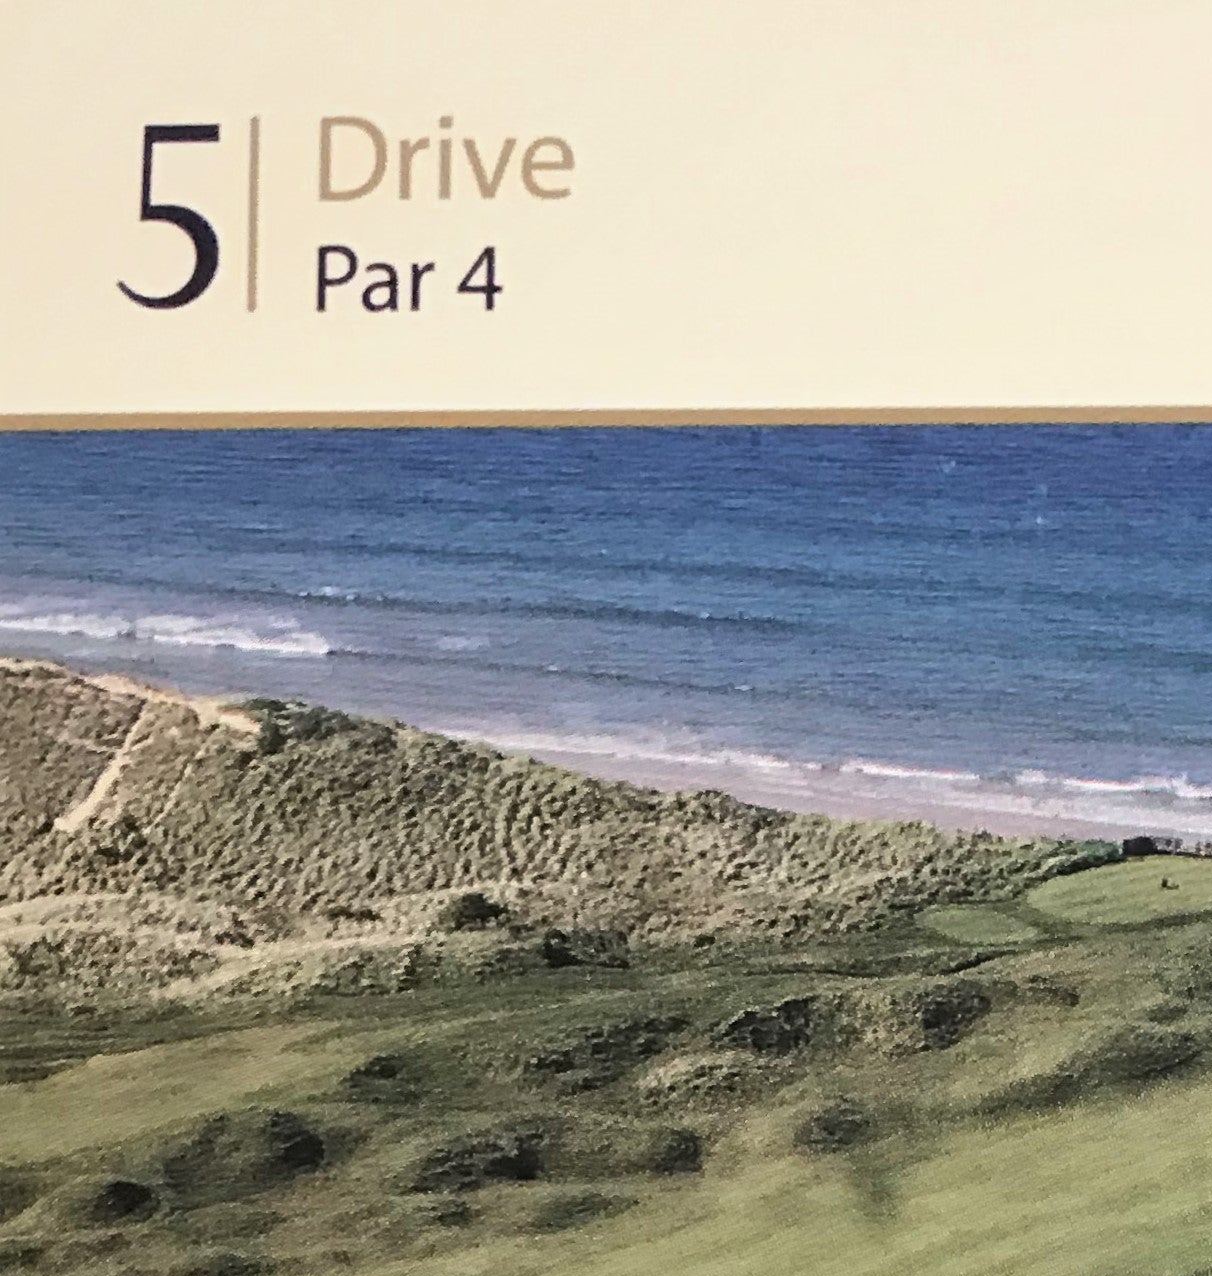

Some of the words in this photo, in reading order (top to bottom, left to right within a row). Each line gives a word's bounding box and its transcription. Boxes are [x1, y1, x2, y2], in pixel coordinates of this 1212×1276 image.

[316, 115, 574, 201] Drive
[116, 123, 220, 309] 5
[315, 245, 434, 312] Par
[457, 247, 504, 311] 4
